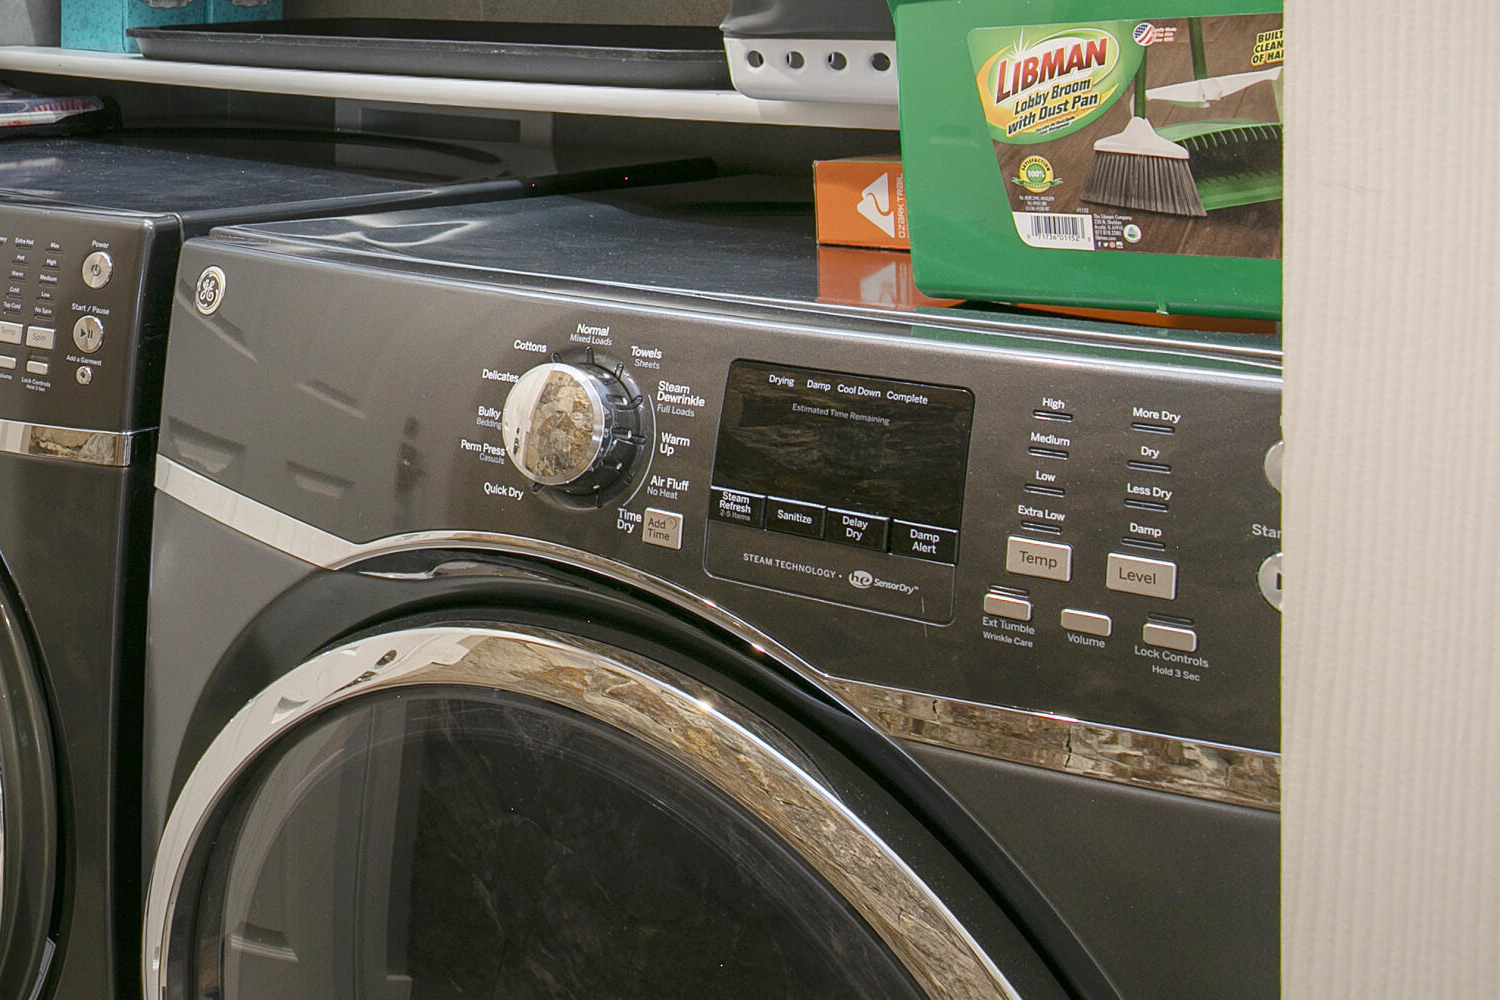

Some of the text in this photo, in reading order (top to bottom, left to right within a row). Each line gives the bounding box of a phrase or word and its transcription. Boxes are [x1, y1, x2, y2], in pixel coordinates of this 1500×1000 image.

[1252, 50, 1284, 63] OF HAI
[995, 37, 1108, 104] LIBMAN
[1015, 79, 1091, 116] Lobby Broom
[1007, 112, 1036, 135] with
[1038, 99, 1070, 121] Dust
[1071, 93, 1099, 111] Pan
[1021, 157, 1051, 172] SATISFACTION
[1027, 170, 1045, 178] 100%
[91, 240, 110, 249] Power
[71, 303, 87, 312] Start
[92, 305, 110, 316] Pause
[576, 323, 610, 337] Normal
[32, 333, 46, 343] Spin
[569, 334, 612, 346] Mixed Loads
[514, 340, 547, 353] Cottons
[631, 345, 662, 359] Towels
[634, 358, 660, 370] Sheets
[482, 368, 520, 384] Delicates
[768, 374, 795, 387] Drying
[658, 380, 691, 395] Steam
[807, 380, 831, 392] Damp
[837, 384, 881, 398] Cool Down
[657, 390, 705, 407] Dewrinkle
[886, 391, 928, 405] Complete
[1042, 397, 1065, 410] High
[478, 405, 501, 420] Bulky
[657, 404, 695, 418] Full Loads
[792, 403, 890, 426] Estimated Time Remaining
[1132, 406, 1181, 424] More Dry
[476, 416, 502, 430] Bedding
[661, 432, 690, 447] Warm
[1030, 432, 1070, 447] Medium
[461, 439, 505, 457] Perm Press
[660, 444, 675, 456] Up
[1140, 446, 1160, 460] Dry
[479, 452, 505, 465] Casuals
[650, 475, 690, 492] Air Fluff
[1035, 470, 1056, 483] Low
[484, 482, 524, 500] Quick Dry
[647, 486, 678, 500] No Heat
[722, 491, 750, 504] Steam
[1127, 483, 1172, 501] Less Dry
[719, 500, 751, 514] Refresh
[1018, 504, 1066, 522] Extra Low
[618, 508, 642, 523] Time
[777, 509, 812, 525] Sanitize
[617, 519, 635, 533] Dry
[648, 518, 666, 529] Add
[842, 516, 868, 530] Delay
[1129, 522, 1162, 538] Damp
[648, 528, 670, 541] Time
[846, 528, 863, 542] Dry
[910, 529, 940, 543] Damp
[1252, 523, 1282, 539] Star
[912, 541, 937, 554] Alert
[743, 552, 836, 579] STEAM TECHNOLOGY
[1019, 550, 1058, 570] Temp
[1118, 566, 1157, 585] Level
[982, 616, 1035, 635] Ext Tumble
[982, 631, 1033, 648] Wrinkle Care
[1067, 632, 1106, 648] Volume
[1134, 645, 1209, 668] Lock Controls
[1151, 664, 1200, 682] Hold 3 Sec
